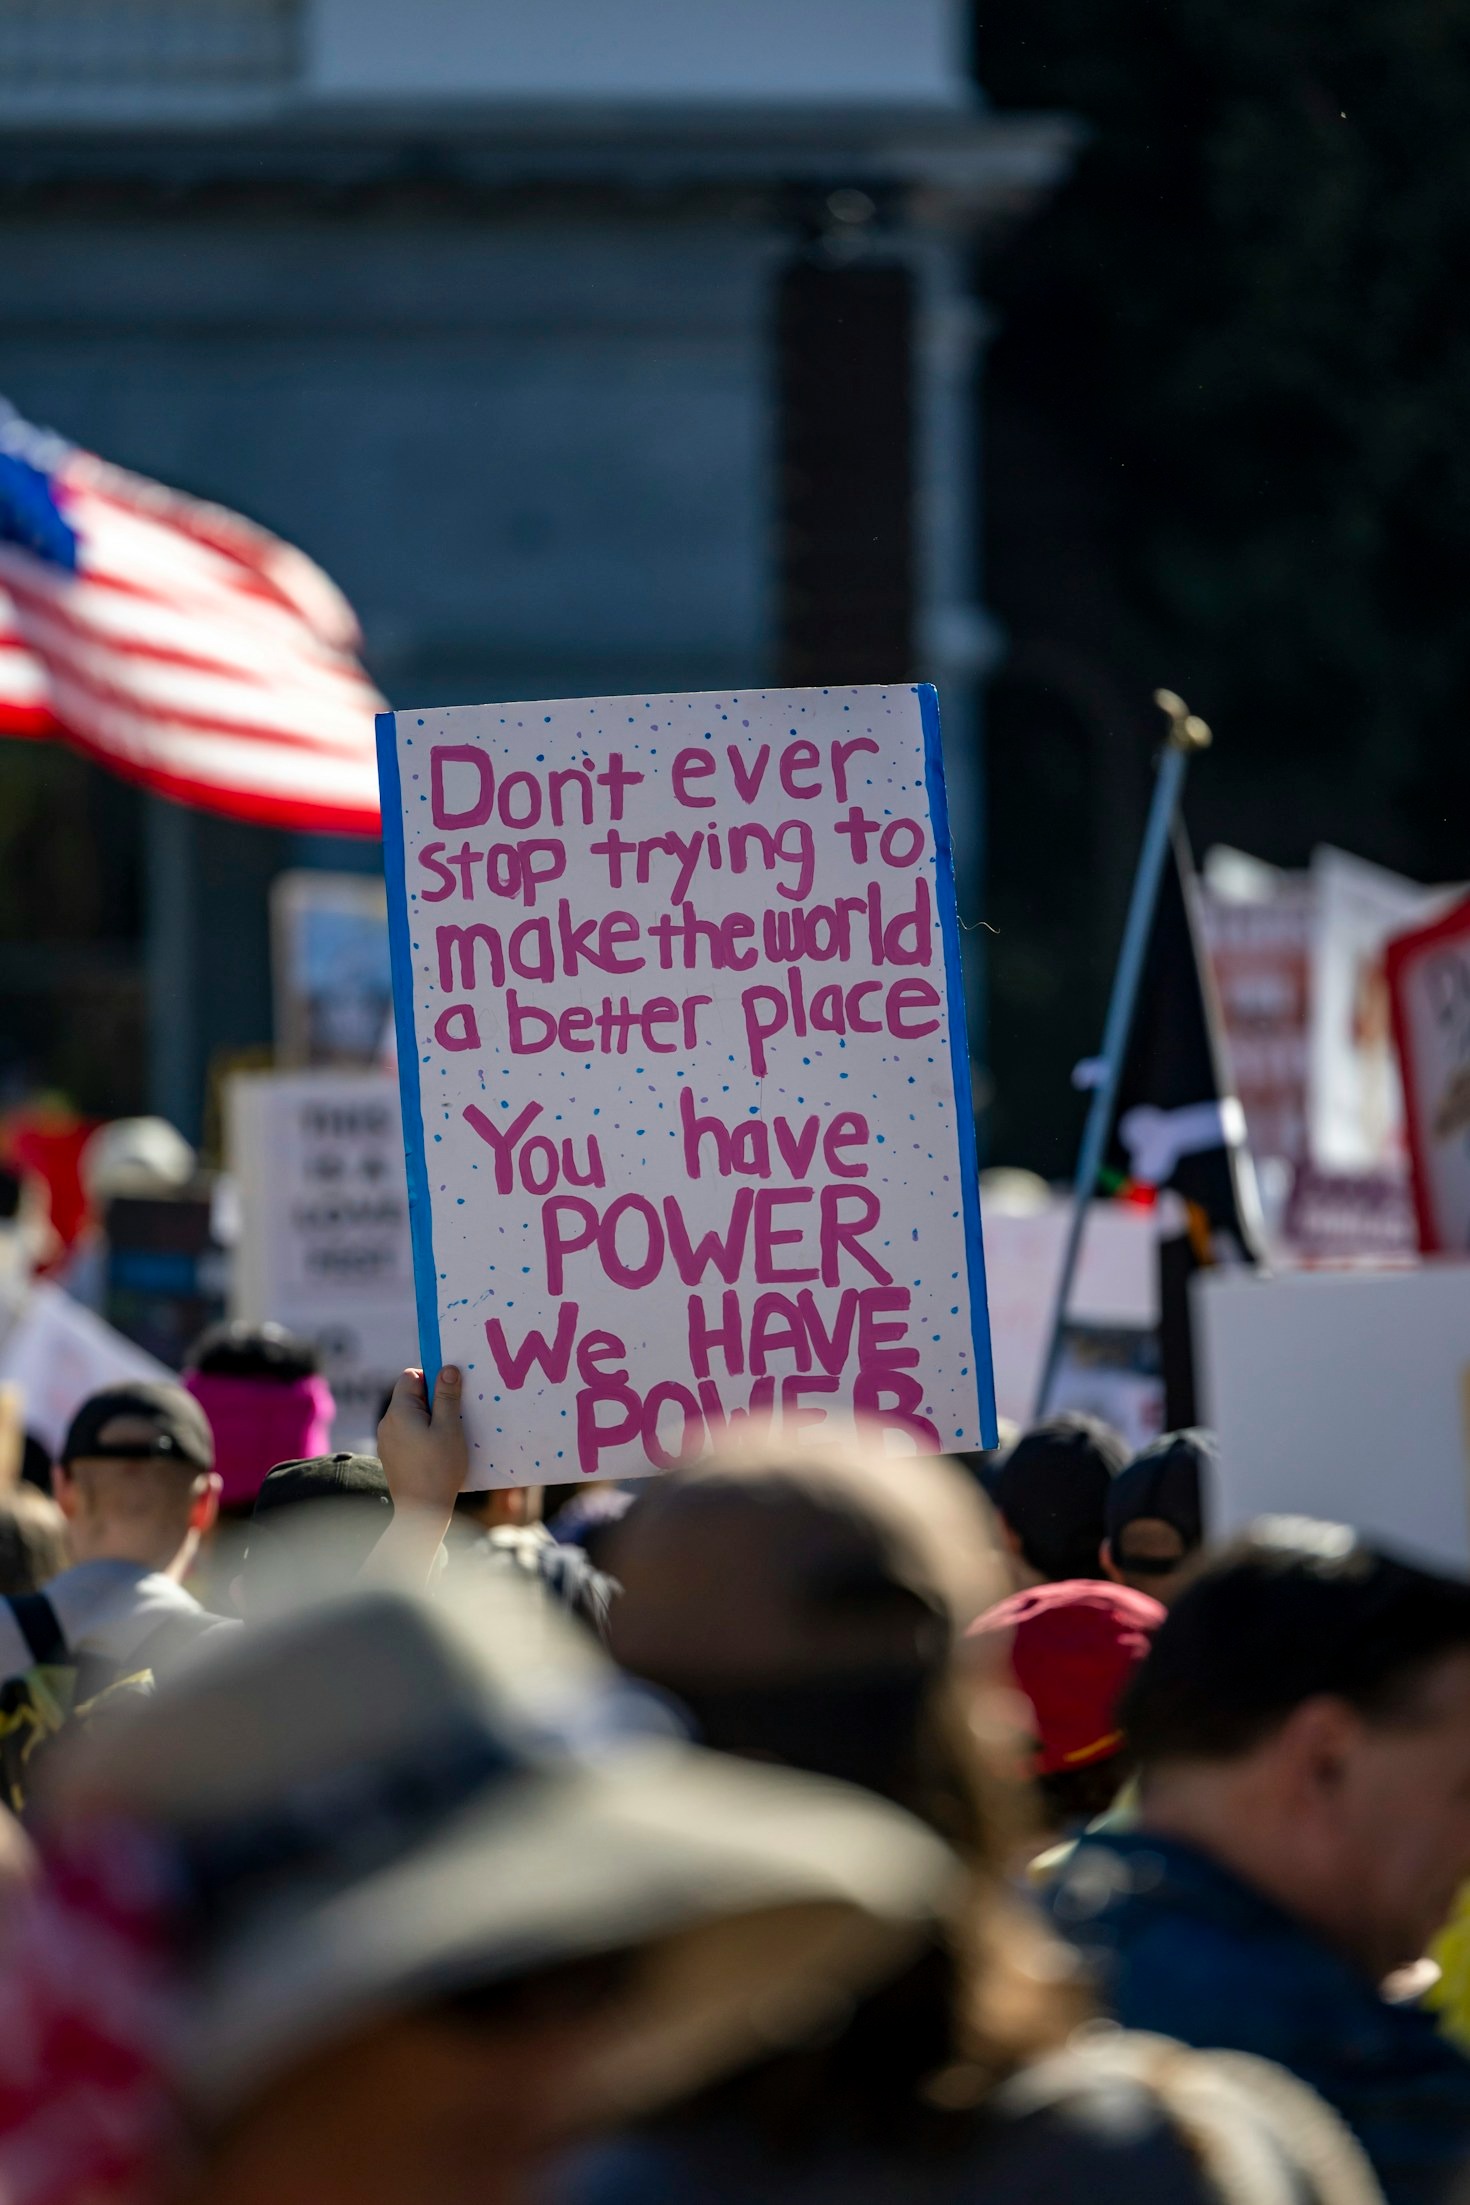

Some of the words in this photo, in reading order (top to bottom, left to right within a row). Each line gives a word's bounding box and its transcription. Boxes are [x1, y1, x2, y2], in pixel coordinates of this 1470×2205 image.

[431, 746, 643, 830] Don't
[672, 738, 878, 807] ever
[419, 839, 566, 907] stop
[590, 820, 814, 907] trying
[836, 807, 924, 867] to
[436, 898, 645, 992] make
[648, 901, 758, 971] the
[763, 876, 931, 966] world
[435, 1004, 480, 1051] a
[506, 989, 711, 1054] better
[742, 967, 940, 1078] place
[464, 1101, 605, 1195] You
[680, 1087, 869, 1179] have
[542, 1184, 893, 1296] POWER
[485, 1302, 629, 1389] We
[688, 1286, 920, 1377] HAVE
